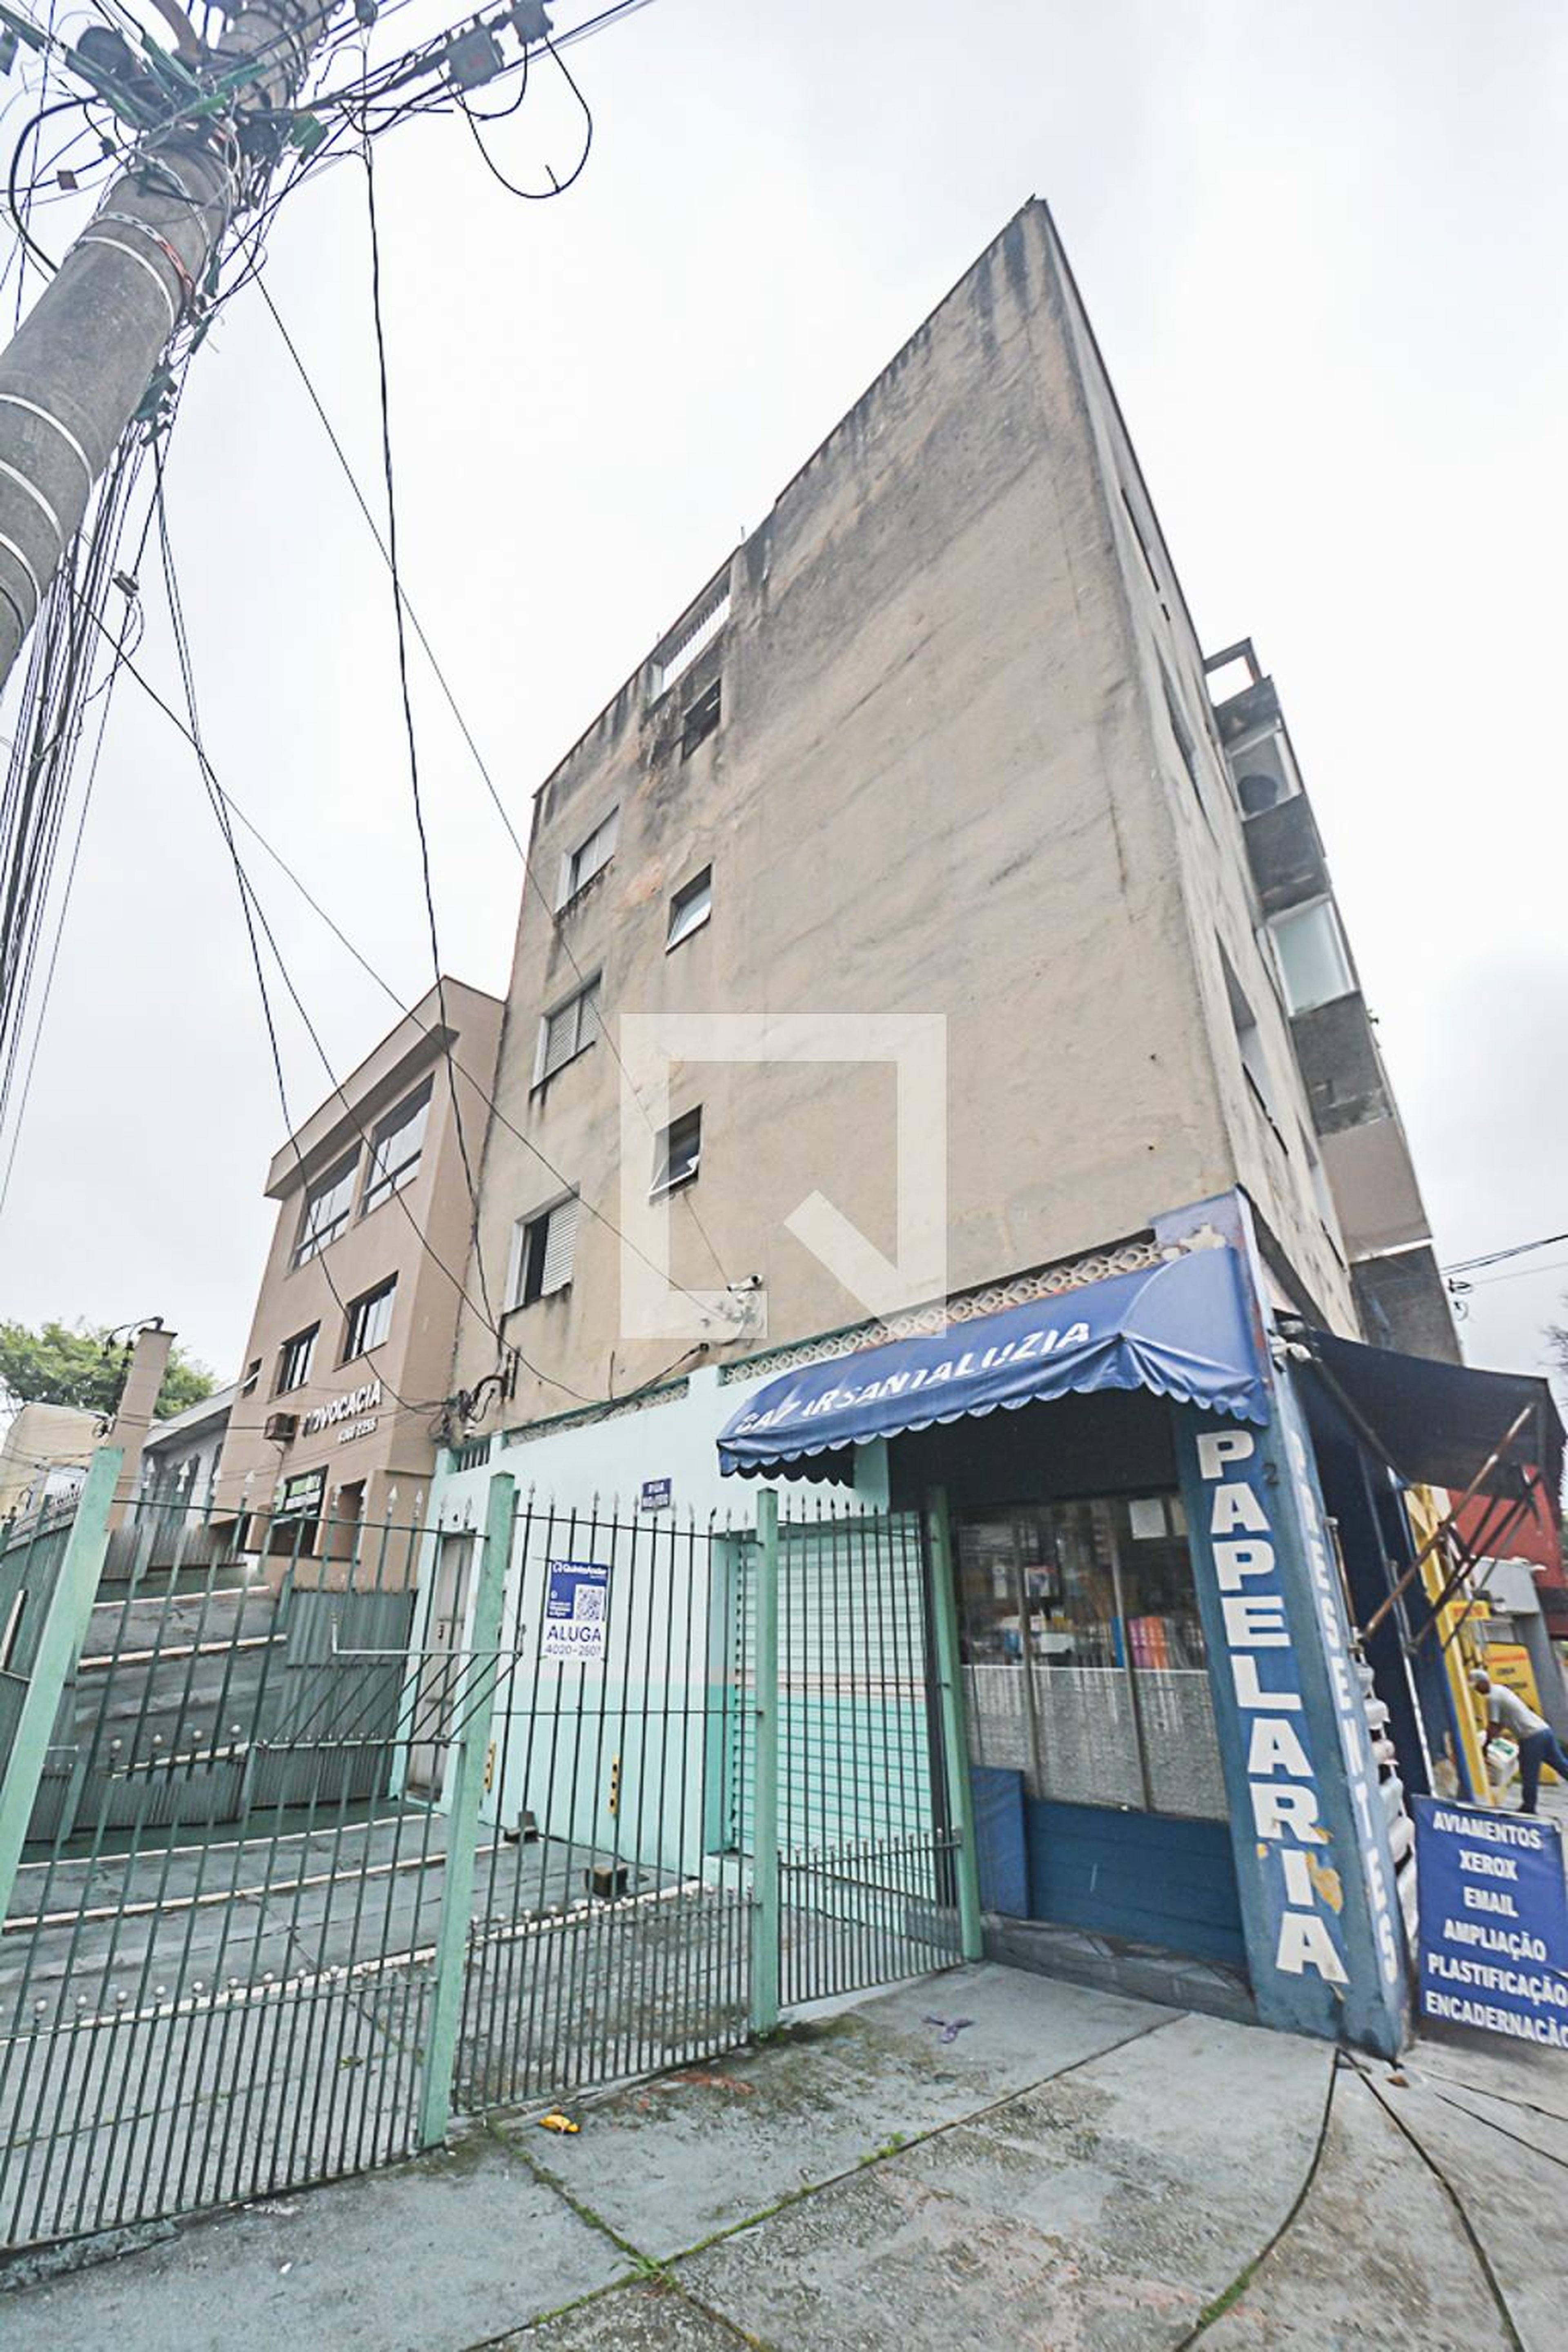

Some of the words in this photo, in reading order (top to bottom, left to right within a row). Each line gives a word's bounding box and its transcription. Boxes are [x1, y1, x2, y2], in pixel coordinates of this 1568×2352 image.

[547, 1625, 601, 1642] ALUGA
[1196, 1430, 1350, 1984] PAPELARIA
[1433, 1811, 1542, 1850] AVIAMENTOS
[1459, 1849, 1519, 1881] XEROX
[1463, 1886, 1519, 1918] EMAIL
[1443, 1918, 1547, 1962] AMPLIAÇÃO
[1428, 1952, 1568, 2007] PLASTIFICAÇÃO
